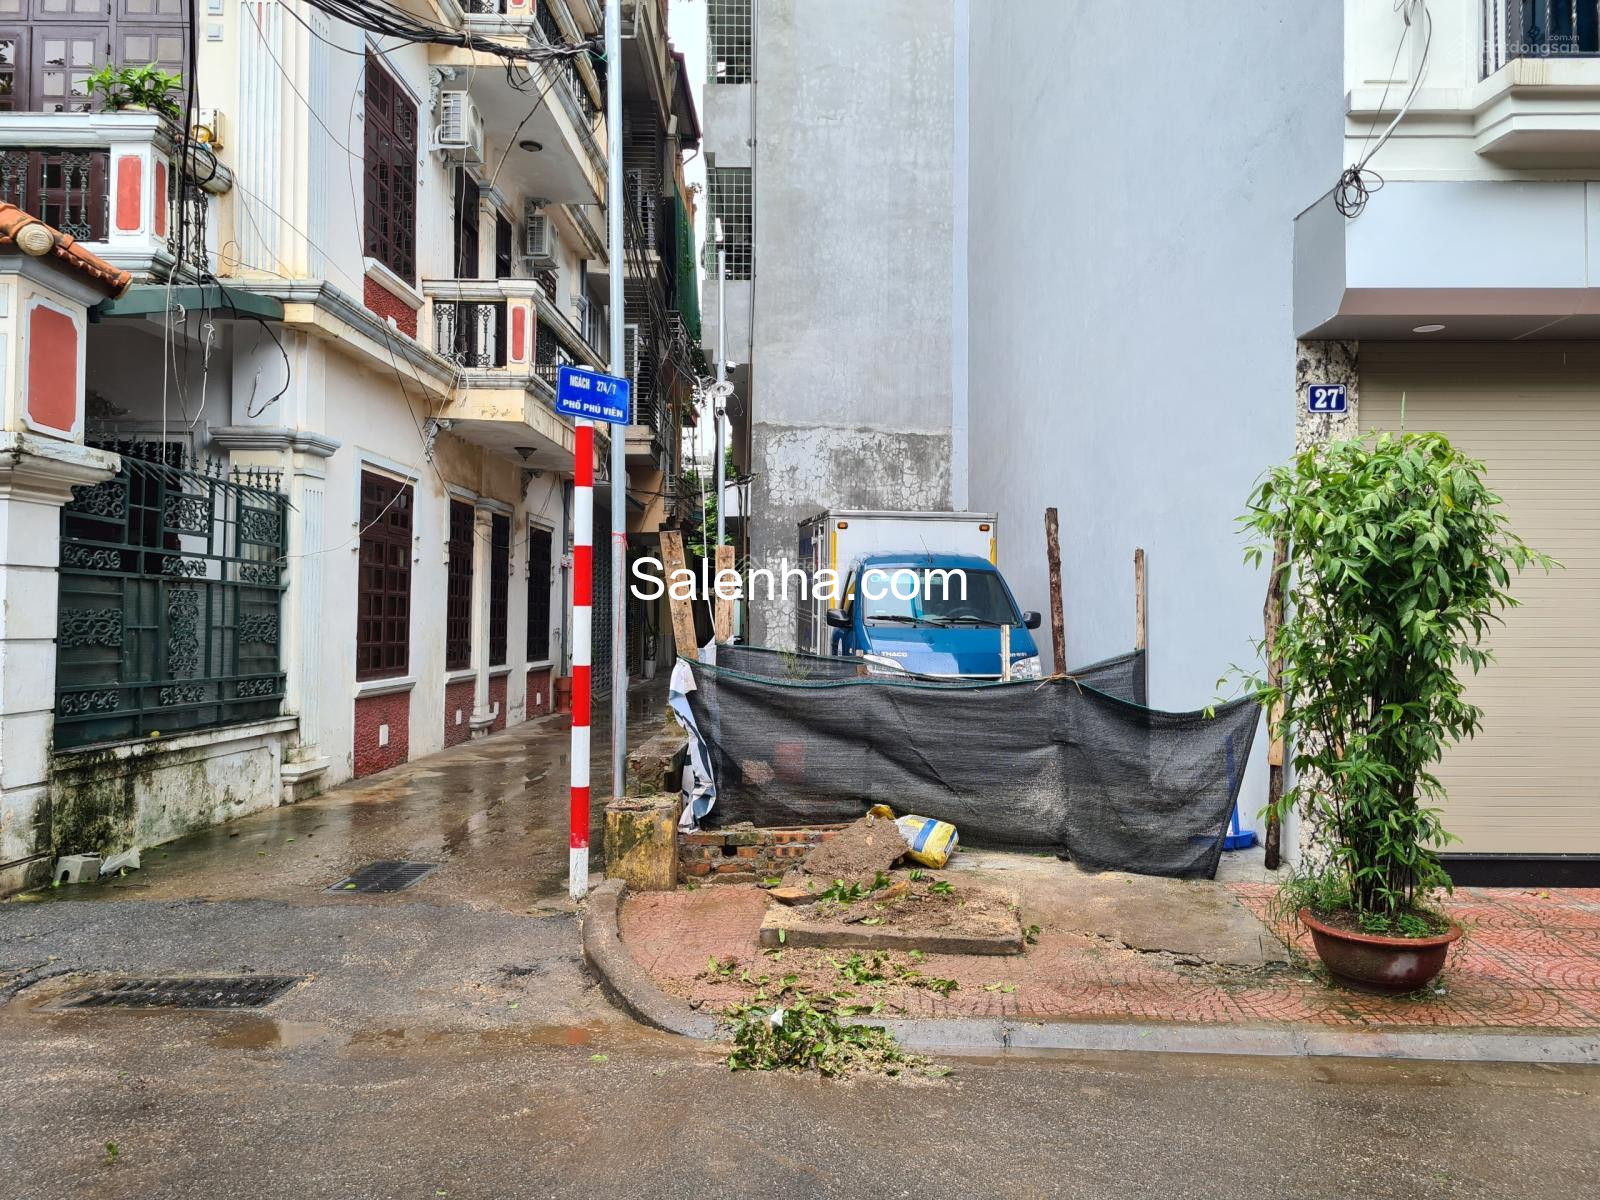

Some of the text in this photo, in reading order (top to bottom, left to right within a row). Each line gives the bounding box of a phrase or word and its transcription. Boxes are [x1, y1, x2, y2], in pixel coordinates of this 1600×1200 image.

[569, 373, 591, 390] NGÁCH
[562, 397, 623, 418] PHỐ PHÚ VIÊN
